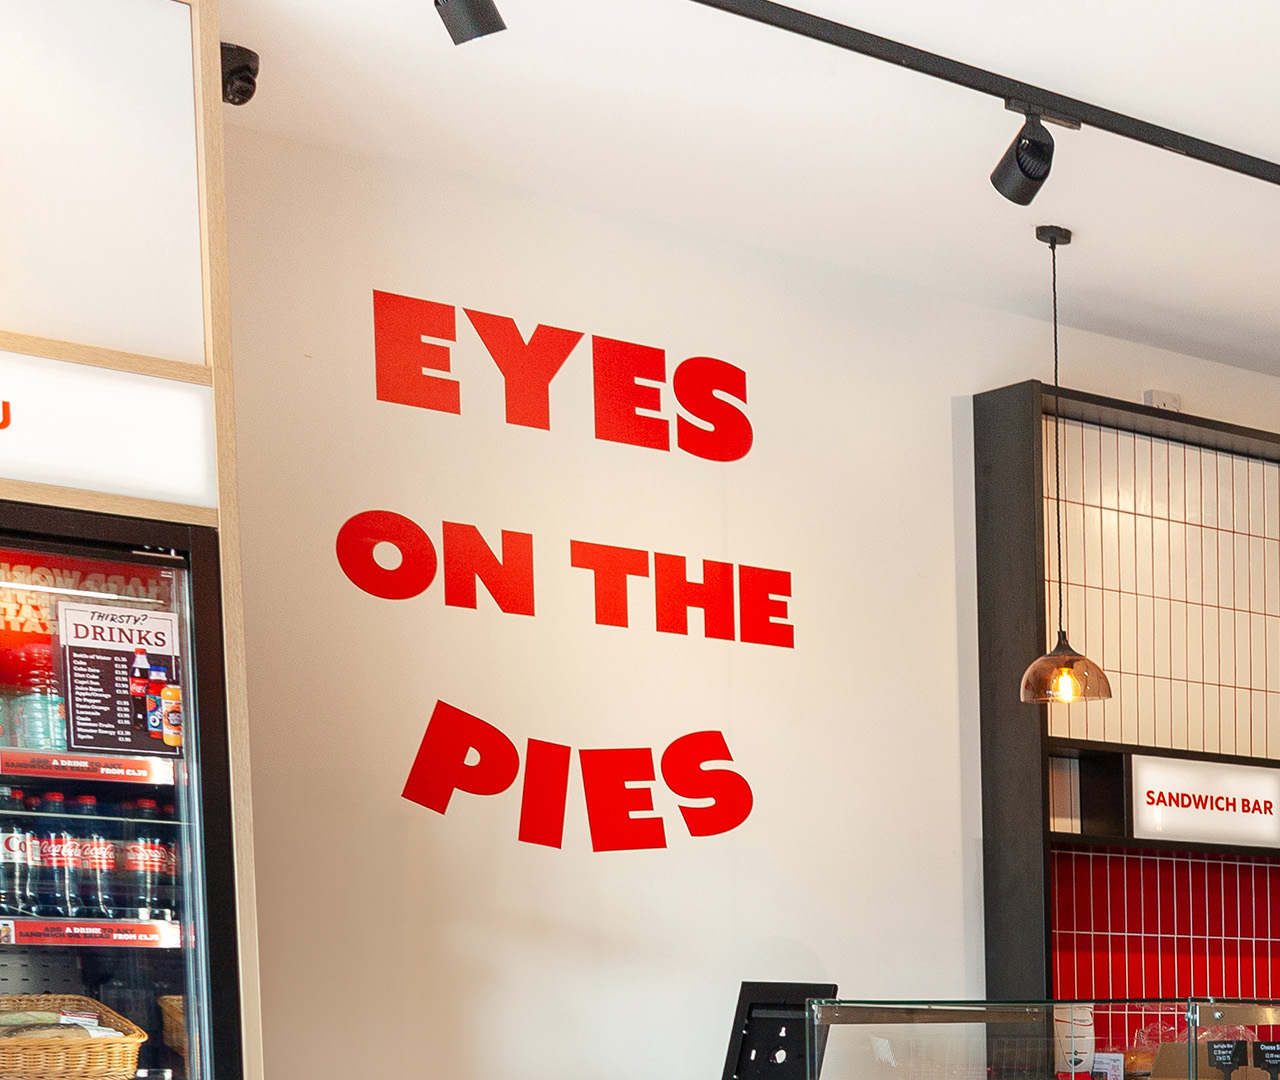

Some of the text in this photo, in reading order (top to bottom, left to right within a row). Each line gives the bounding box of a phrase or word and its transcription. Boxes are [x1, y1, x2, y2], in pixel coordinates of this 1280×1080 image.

[372, 288, 755, 463] EYES
[335, 509, 796, 650] ON THE
[89, 611, 148, 625] THIRSTY?
[73, 623, 166, 647] DRINKS
[60, 760, 89, 768] DRINK
[400, 697, 755, 854] PIES
[1146, 790, 1274, 816] SANDWICH BAR
